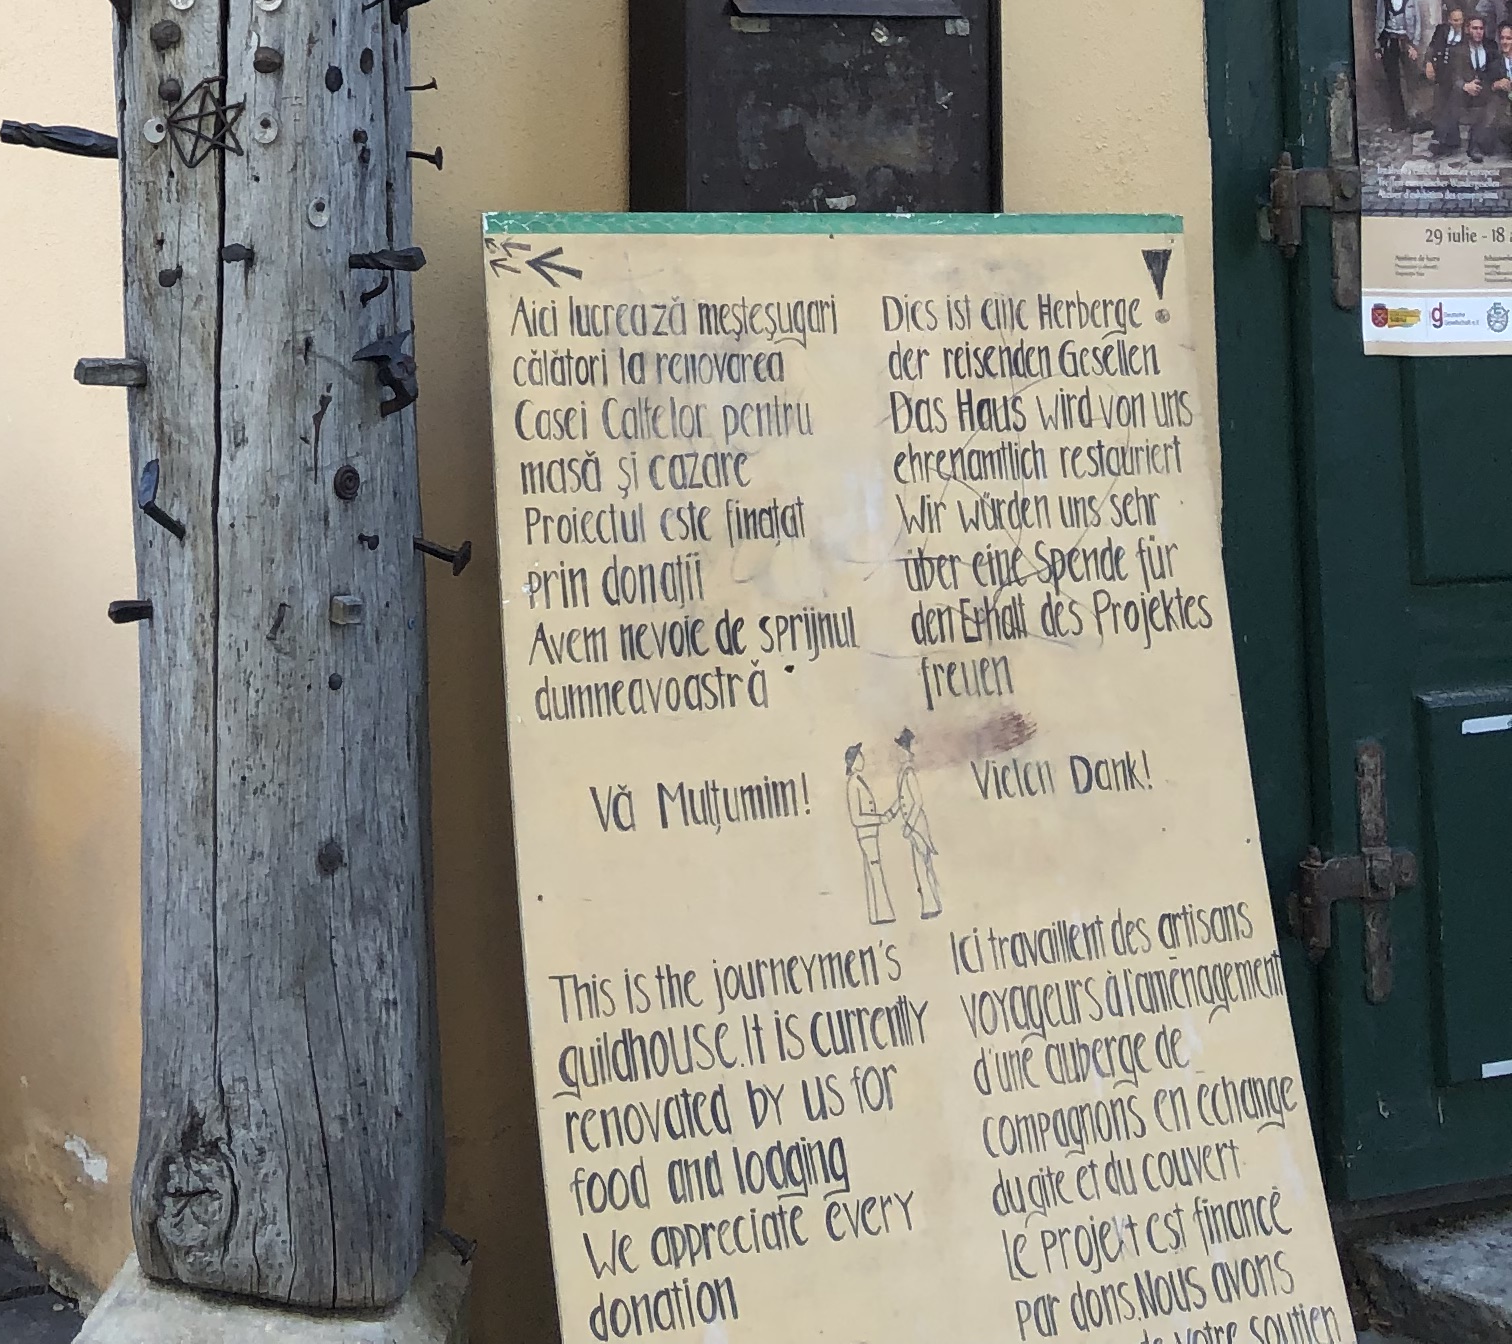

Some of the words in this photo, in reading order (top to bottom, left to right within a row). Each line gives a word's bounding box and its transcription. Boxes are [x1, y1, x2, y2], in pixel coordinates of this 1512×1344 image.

[1425, 228, 1443, 245] 29
[1448, 224, 1477, 243] iulie
[1491, 226, 1505, 243] 18
[510, 297, 558, 337] Aici
[569, 296, 687, 337] lucrează
[697, 295, 838, 349] meșteșugari
[882, 294, 938, 333] Dies
[946, 293, 971, 330] ist
[981, 292, 1028, 330] eine
[1038, 291, 1142, 340] Herberge
[513, 347, 608, 388] călători
[620, 348, 645, 386] la
[655, 349, 785, 385] renovarea
[888, 340, 929, 381] der
[943, 340, 1052, 380] reisenden
[1058, 339, 1161, 378] Gesellen
[515, 398, 588, 441] Casei
[723, 394, 813, 443] pentru
[889, 390, 947, 434] Das
[956, 387, 1027, 433] Haus
[1036, 385, 1094, 431] wird
[1099, 390, 1146, 430] von
[1151, 390, 1194, 429] uns
[520, 450, 602, 495] masă
[617, 453, 639, 499] și
[648, 450, 751, 491] cazare
[893, 439, 1047, 485] ehrenamtlich
[1060, 435, 1182, 479] restauriert
[525, 501, 647, 546] Proiectul
[660, 501, 711, 543] este
[725, 495, 806, 548] finațat
[896, 494, 947, 535] Wir
[957, 490, 1052, 533] würden
[1059, 492, 1102, 530] uns
[1110, 486, 1161, 528] sehr
[527, 560, 589, 610] prin
[602, 552, 705, 610] donații
[903, 547, 962, 592] über
[972, 542, 1028, 588] eine
[1035, 536, 1129, 596] Spende
[1136, 534, 1178, 593] für
[529, 621, 608, 666] Avem
[619, 613, 710, 661] nevoie
[715, 614, 748, 657] de
[759, 606, 860, 662] sprijnul
[911, 600, 955, 647] den
[959, 592, 1029, 644] Erhalt
[1040, 591, 1083, 638] des
[1093, 587, 1214, 649] Projektes
[920, 655, 1014, 711] freuen
[589, 784, 636, 832] Vă
[657, 772, 811, 835] Mulțumim!
[970, 757, 1056, 800] Vielen
[1069, 749, 1153, 795] Dank!
[949, 926, 985, 976] Ici
[987, 914, 1107, 973] travaillent
[1110, 908, 1152, 958] des
[1157, 901, 1254, 950] artisans
[548, 968, 616, 1024] This
[623, 968, 652, 1014] is
[656, 963, 704, 1010] the
[712, 939, 903, 1015] journeymen's
[959, 972, 1103, 1045] voyageurs
[1105, 970, 1124, 1018] à
[774, 1009, 805, 1062] is
[810, 994, 929, 1060] currently
[972, 1042, 1040, 1097] d'une
[1044, 1029, 1148, 1091] auberge
[1155, 1024, 1190, 1070] de
[565, 1083, 733, 1155] renovated
[745, 1079, 785, 1130] by
[801, 1073, 845, 1123] us
[850, 1062, 898, 1114] for
[982, 1092, 1147, 1160] compagnons
[1153, 1083, 1192, 1133] en
[569, 1155, 651, 1217] food
[667, 1149, 725, 1206] and
[732, 1135, 852, 1202] lodging
[992, 1168, 1027, 1217] du
[1076, 1159, 1101, 1202] et
[1104, 1149, 1138, 1199] du
[1142, 1138, 1242, 1193] couvert
[582, 1228, 640, 1281] We
[650, 1203, 809, 1271] appreciate
[825, 1189, 916, 1243] every
[1146, 1201, 1187, 1256] est
[589, 1275, 740, 1342] donation
[1014, 1292, 1061, 1342] par
[1211, 1249, 1296, 1304] avons
